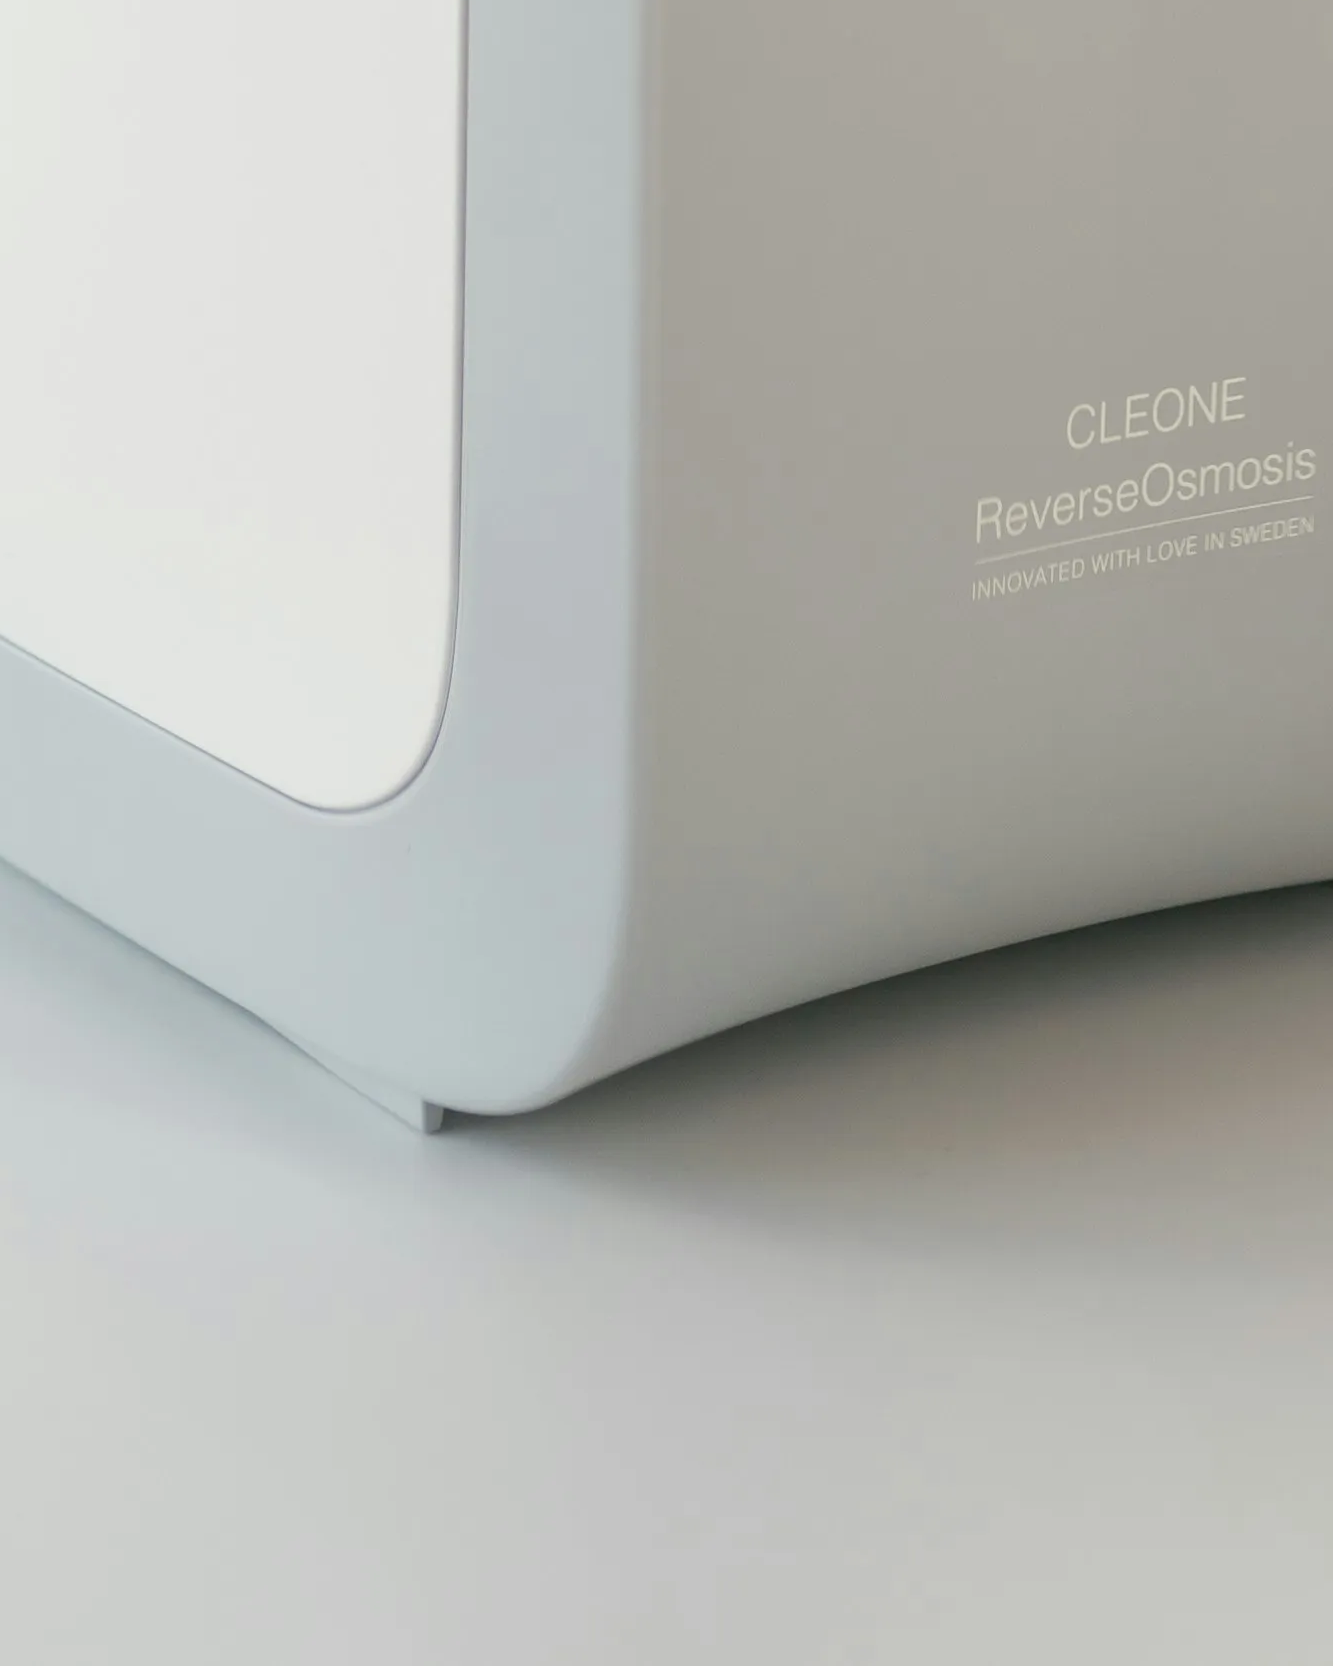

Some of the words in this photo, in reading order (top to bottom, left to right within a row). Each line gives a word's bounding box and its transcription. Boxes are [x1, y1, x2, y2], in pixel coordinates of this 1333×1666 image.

[1067, 376, 1247, 449] CLEONE
[976, 441, 1317, 544] ReverseOsmosis
[971, 559, 1085, 601] INNOVATED
[1091, 546, 1140, 575] WITH
[1146, 535, 1198, 563] LOVE
[1204, 531, 1225, 552] IN
[1230, 514, 1315, 548] SWEDEN
